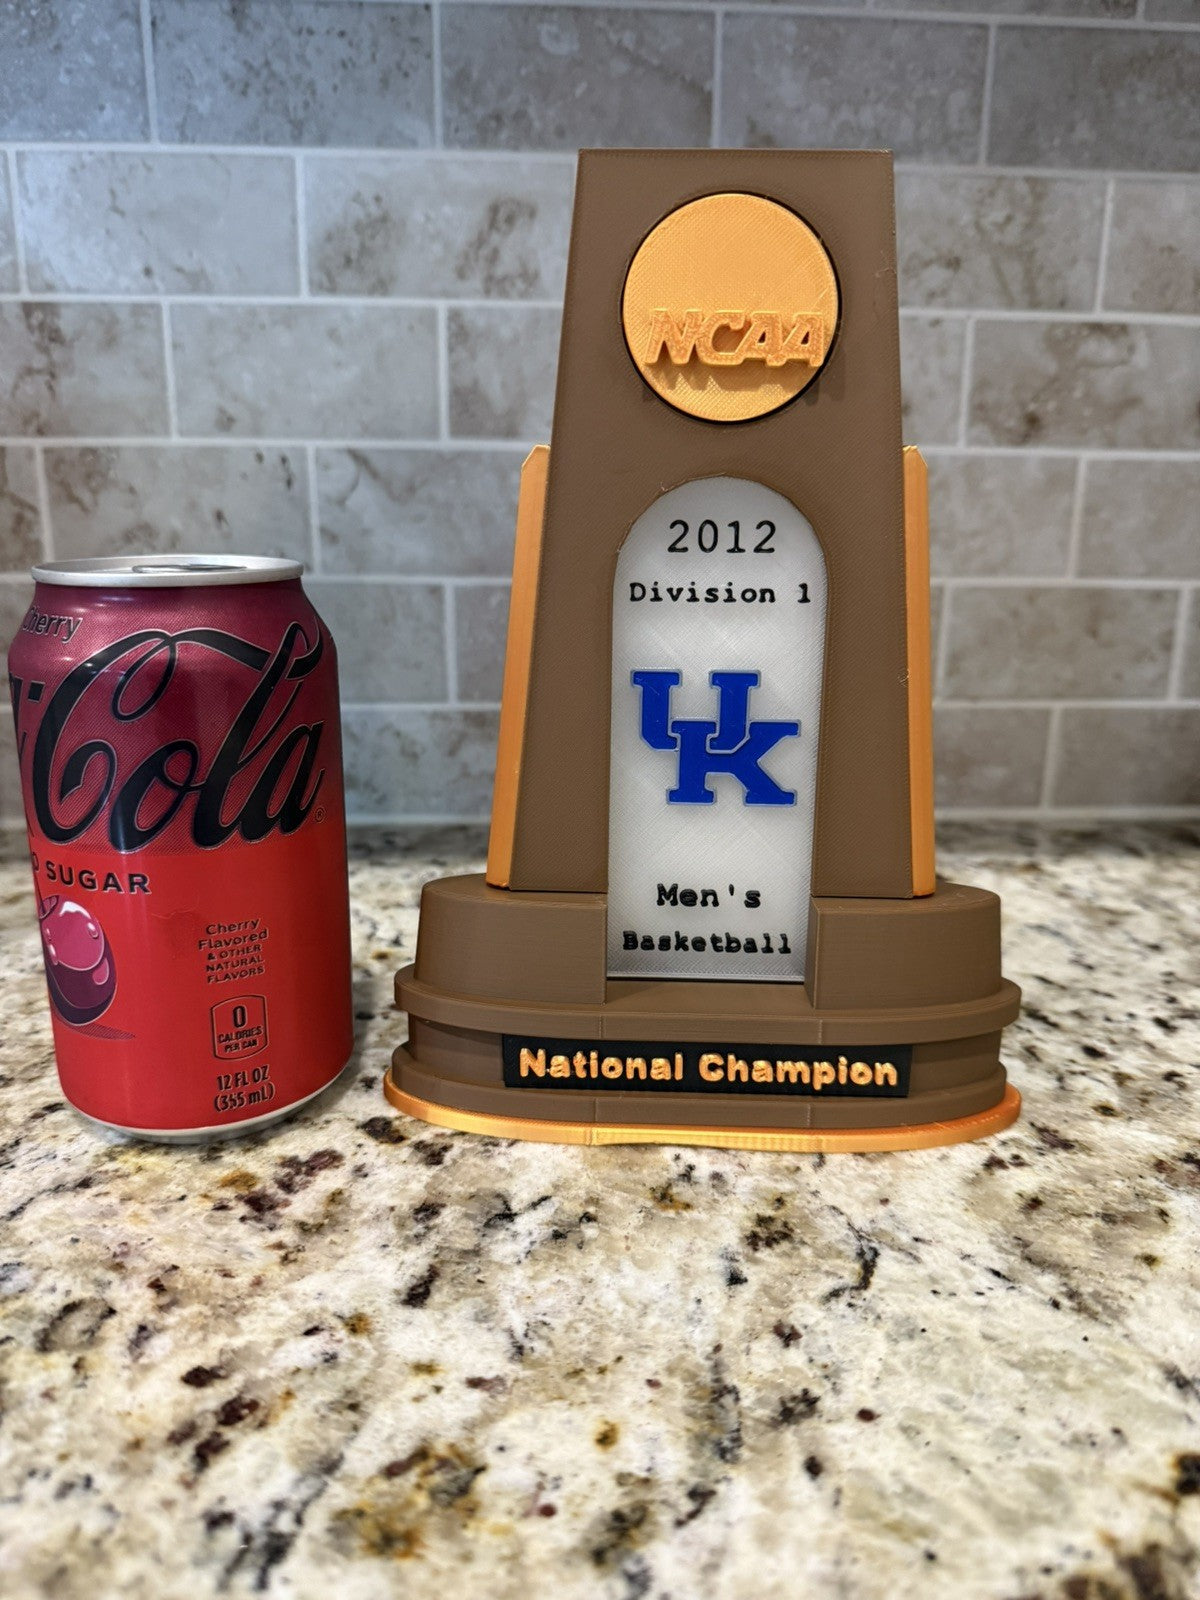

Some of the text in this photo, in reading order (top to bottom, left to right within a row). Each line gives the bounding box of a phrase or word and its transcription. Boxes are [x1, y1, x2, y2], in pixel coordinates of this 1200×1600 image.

[645, 308, 825, 367] NCAA
[667, 519, 776, 553] 2012
[629, 582, 811, 603] Division 1
[32, 621, 326, 853] Cola
[632, 670, 801, 805] UK
[45, 860, 152, 894] SUGAR
[656, 883, 761, 909] Men's
[205, 918, 261, 935] Cherry
[198, 928, 269, 951] Flavored
[219, 944, 262, 959] OTHER
[622, 930, 792, 954] Basketball
[206, 955, 265, 972] NATURAL
[207, 965, 265, 984] FLAVORS
[232, 1005, 247, 1029] 0
[218, 1026, 263, 1044] CALORIES
[224, 1039, 259, 1053] PER CAN
[216, 1064, 270, 1091] 12 FL OZ
[519, 1048, 899, 1091] National Champion
[214, 1082, 276, 1112] (355 mL)
